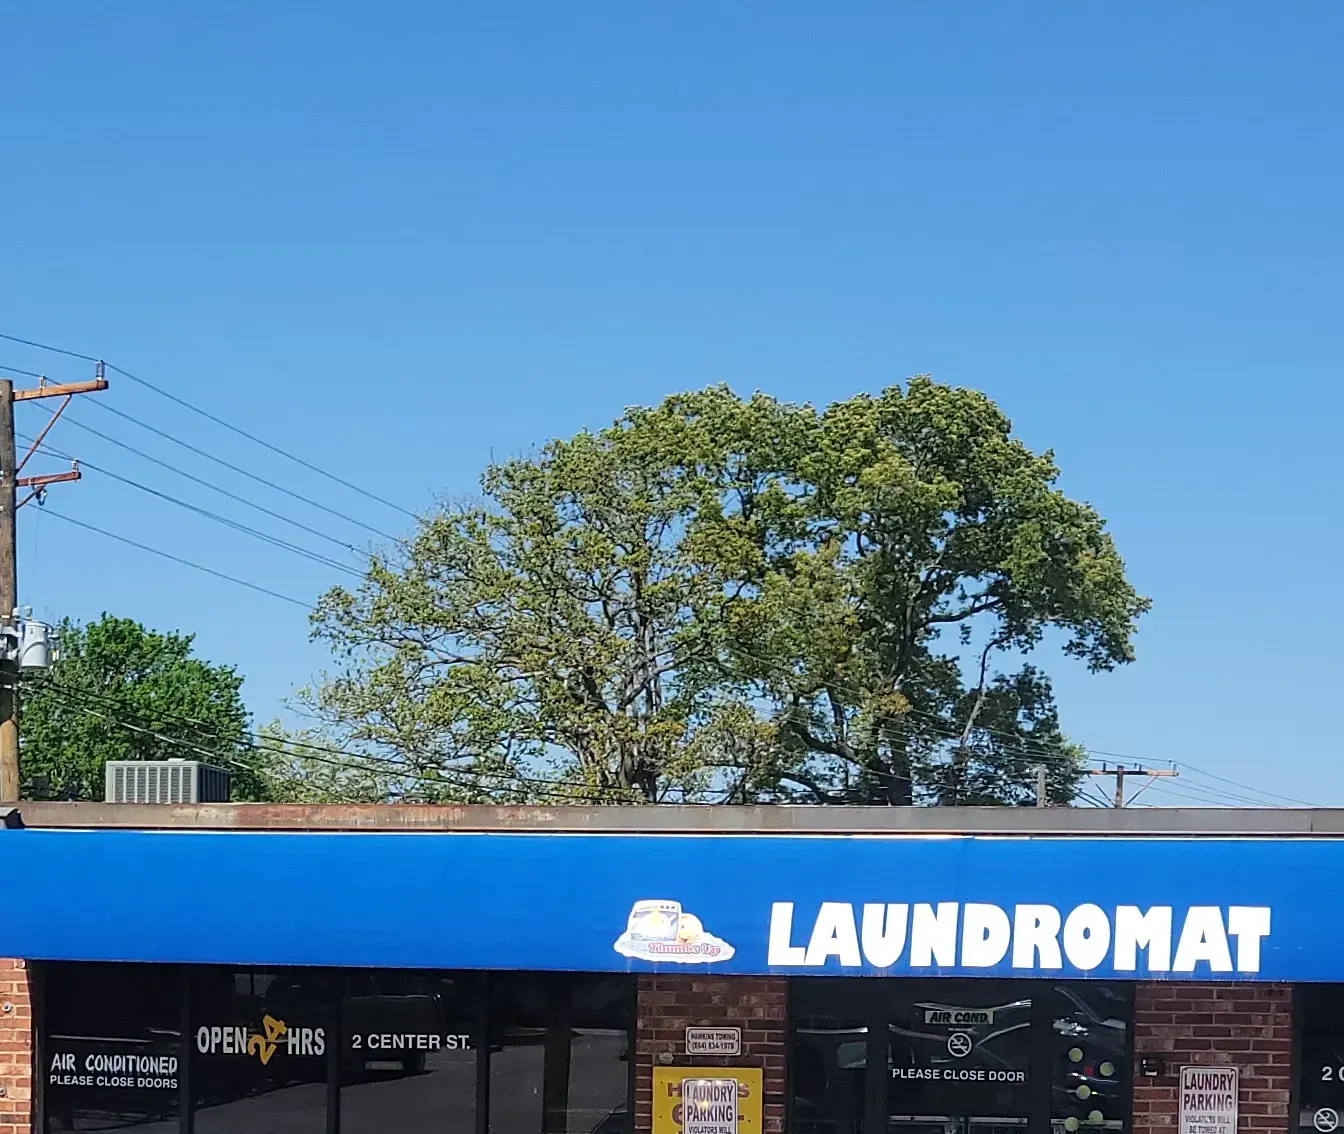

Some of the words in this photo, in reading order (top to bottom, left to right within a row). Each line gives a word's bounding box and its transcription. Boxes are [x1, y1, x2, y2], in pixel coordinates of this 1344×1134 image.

[767, 901, 1272, 972] LAUNDROMAT
[648, 943, 700, 954] Thumbs
[701, 943, 721, 957] Up
[929, 1011, 952, 1023] AIR
[197, 1026, 247, 1054] OPEN
[247, 1014, 287, 1065] 24
[287, 1027, 325, 1055] HRS
[352, 1034, 362, 1048] 2
[367, 1034, 441, 1049] CENTER
[446, 1034, 471, 1050] ST.
[50, 1053, 76, 1072] AIR
[84, 1054, 178, 1075] CONDITIONED
[892, 1068, 940, 1079] PLEASE
[943, 1069, 985, 1081] CLOSE
[988, 1071, 1025, 1082] DOOR
[1321, 1066, 1333, 1081] 2
[50, 1075, 94, 1086] PLEASE
[96, 1076, 135, 1087] CLOSE
[137, 1077, 178, 1089] DOORS
[1184, 1073, 1234, 1091] LAUNDRY
[686, 1085, 733, 1102] LAUNDRY
[1184, 1093, 1233, 1111] PARKING
[687, 1105, 733, 1122] PARKING
[1185, 1115, 1216, 1124] VIOLATORS
[1217, 1116, 1230, 1124] WILL
[688, 1126, 717, 1134] VIOLATORS
[1189, 1125, 1197, 1134] BE
[1198, 1126, 1217, 1134] TOWED
